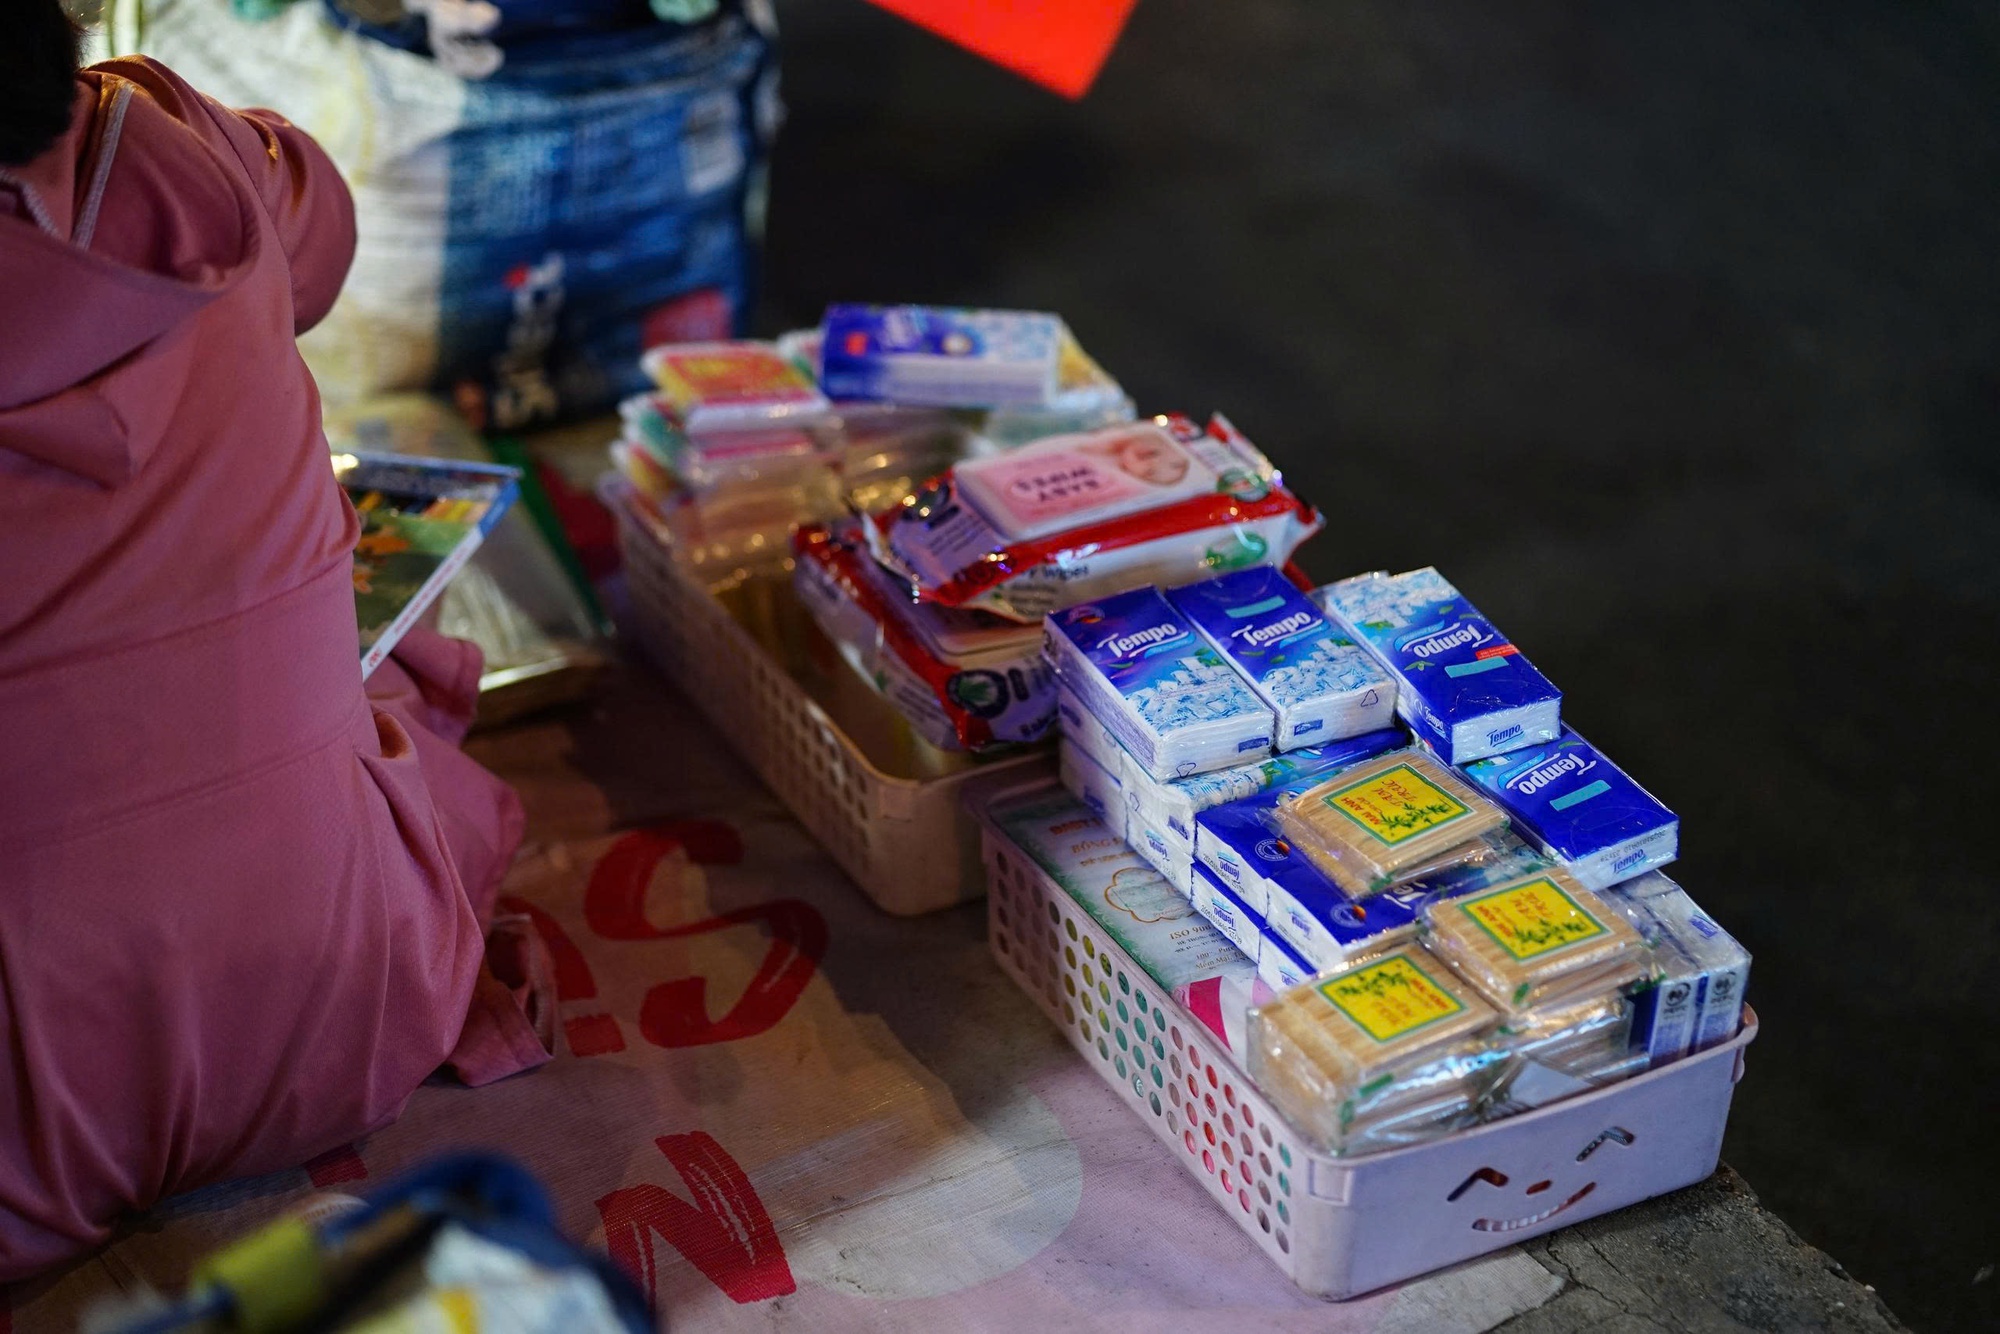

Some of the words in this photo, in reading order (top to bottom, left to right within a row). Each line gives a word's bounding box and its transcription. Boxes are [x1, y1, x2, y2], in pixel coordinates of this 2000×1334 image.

[1097, 623, 1178, 658] Tempo
[1231, 612, 1312, 647] Tempo
[1413, 623, 1494, 658] Tempo
[1424, 706, 1444, 731] Tempo
[1486, 724, 1522, 747] Tempo
[1518, 752, 1597, 795] Tempo
[1218, 860, 1241, 885] Tempo
[1610, 848, 1645, 875] Tempo
[1212, 905, 1237, 931] Tempo
[1169, 928, 1190, 940] ISO
